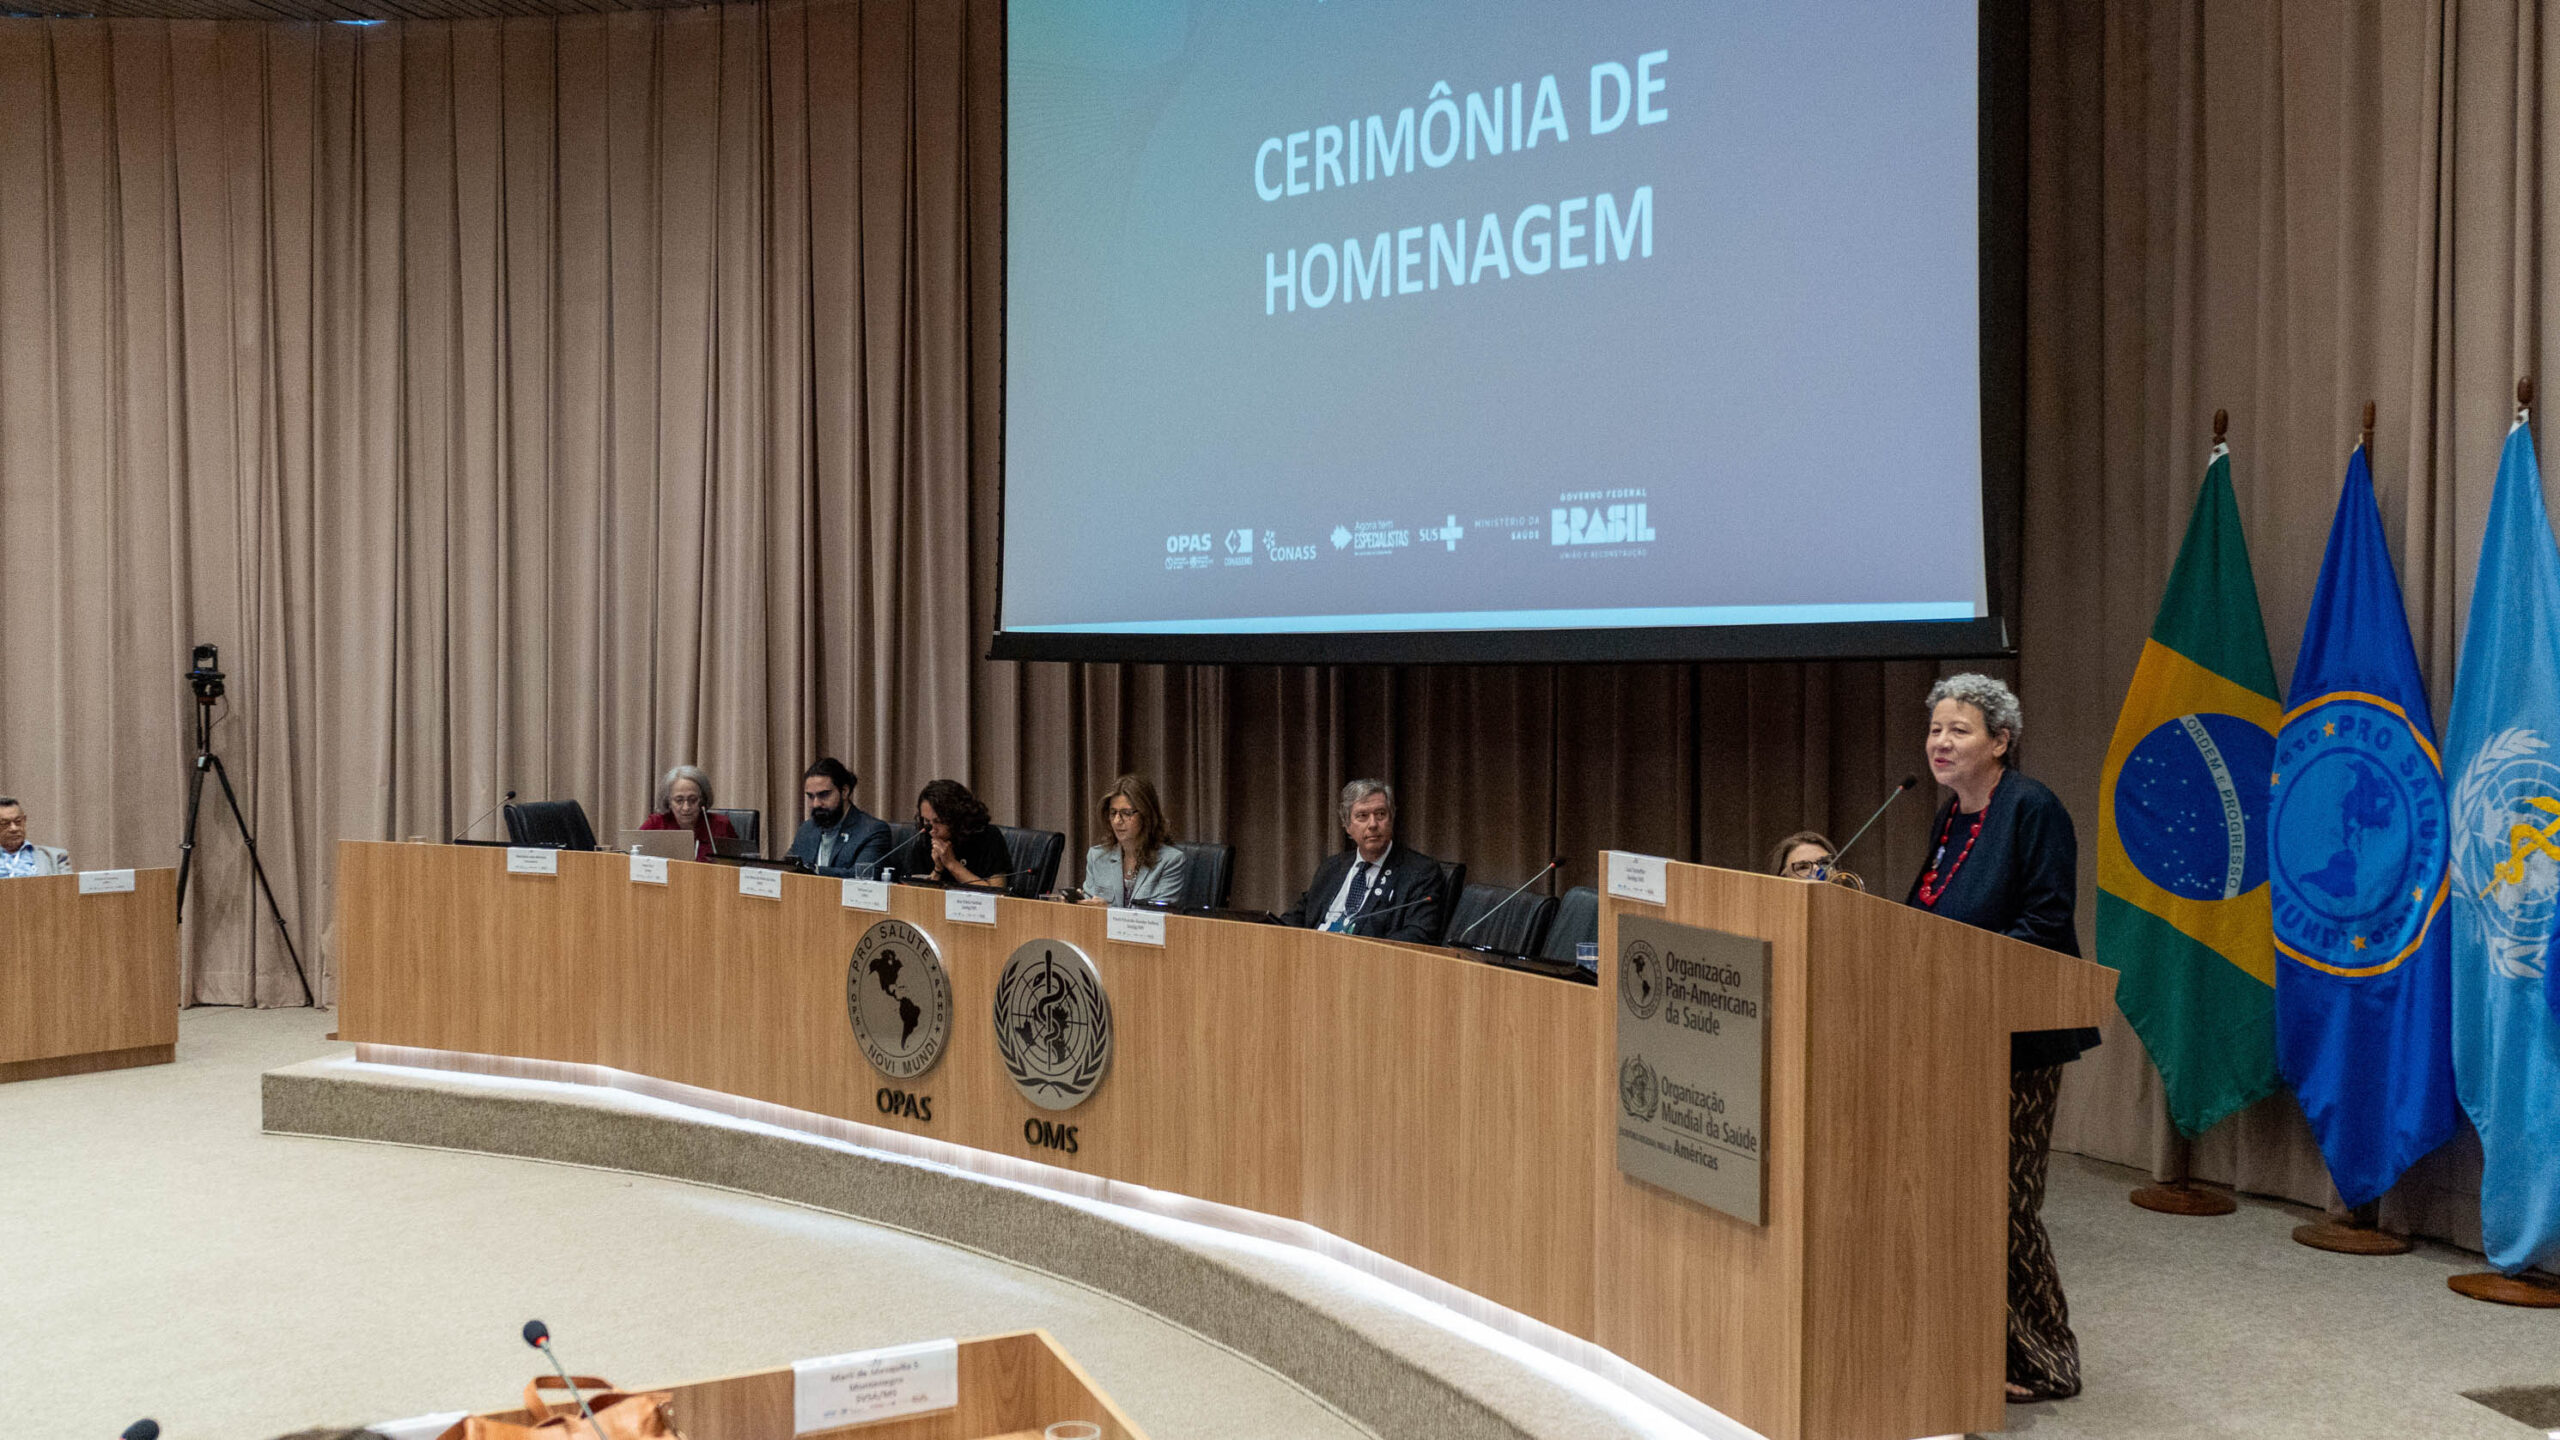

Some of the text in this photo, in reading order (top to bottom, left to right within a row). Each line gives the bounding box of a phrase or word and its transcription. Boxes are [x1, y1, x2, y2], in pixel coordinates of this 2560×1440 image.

[1254, 48, 1669, 202] CERIMÔNIA DE
[1266, 184, 1654, 316] HOMENAGEM
[1559, 487, 1648, 502] GOVERNO FEDERAL
[1354, 530, 1409, 549] ESPECIALISTAS
[1419, 528, 1439, 542] SUS
[1551, 502, 1656, 546] BRASIL
[1166, 533, 1212, 553] OPAS
[1269, 545, 1317, 562] CONASS
[2338, 714, 2393, 751] PRO
[2186, 717, 2223, 771] ORDEM
[2221, 788, 2245, 889] PROGRESSO
[851, 923, 932, 973] PRO SALUTE
[1666, 951, 1741, 993] Organização
[850, 993, 861, 1026] OPS
[934, 978, 944, 1023] PAHO
[1665, 976, 1757, 1019] Pan-Americana
[1665, 1001, 1720, 1036] da Saúde
[868, 1037, 939, 1075] NOVI MUNDI
[876, 1087, 932, 1122] OPAS
[1661, 1075, 1725, 1117] Organização
[1023, 1117, 1079, 1153] OMS
[1661, 1101, 1703, 1134] Mundial
[1705, 1115, 1720, 1140] da
[1722, 1121, 1757, 1153] Saúde
[1673, 1139, 1719, 1171] Américas
